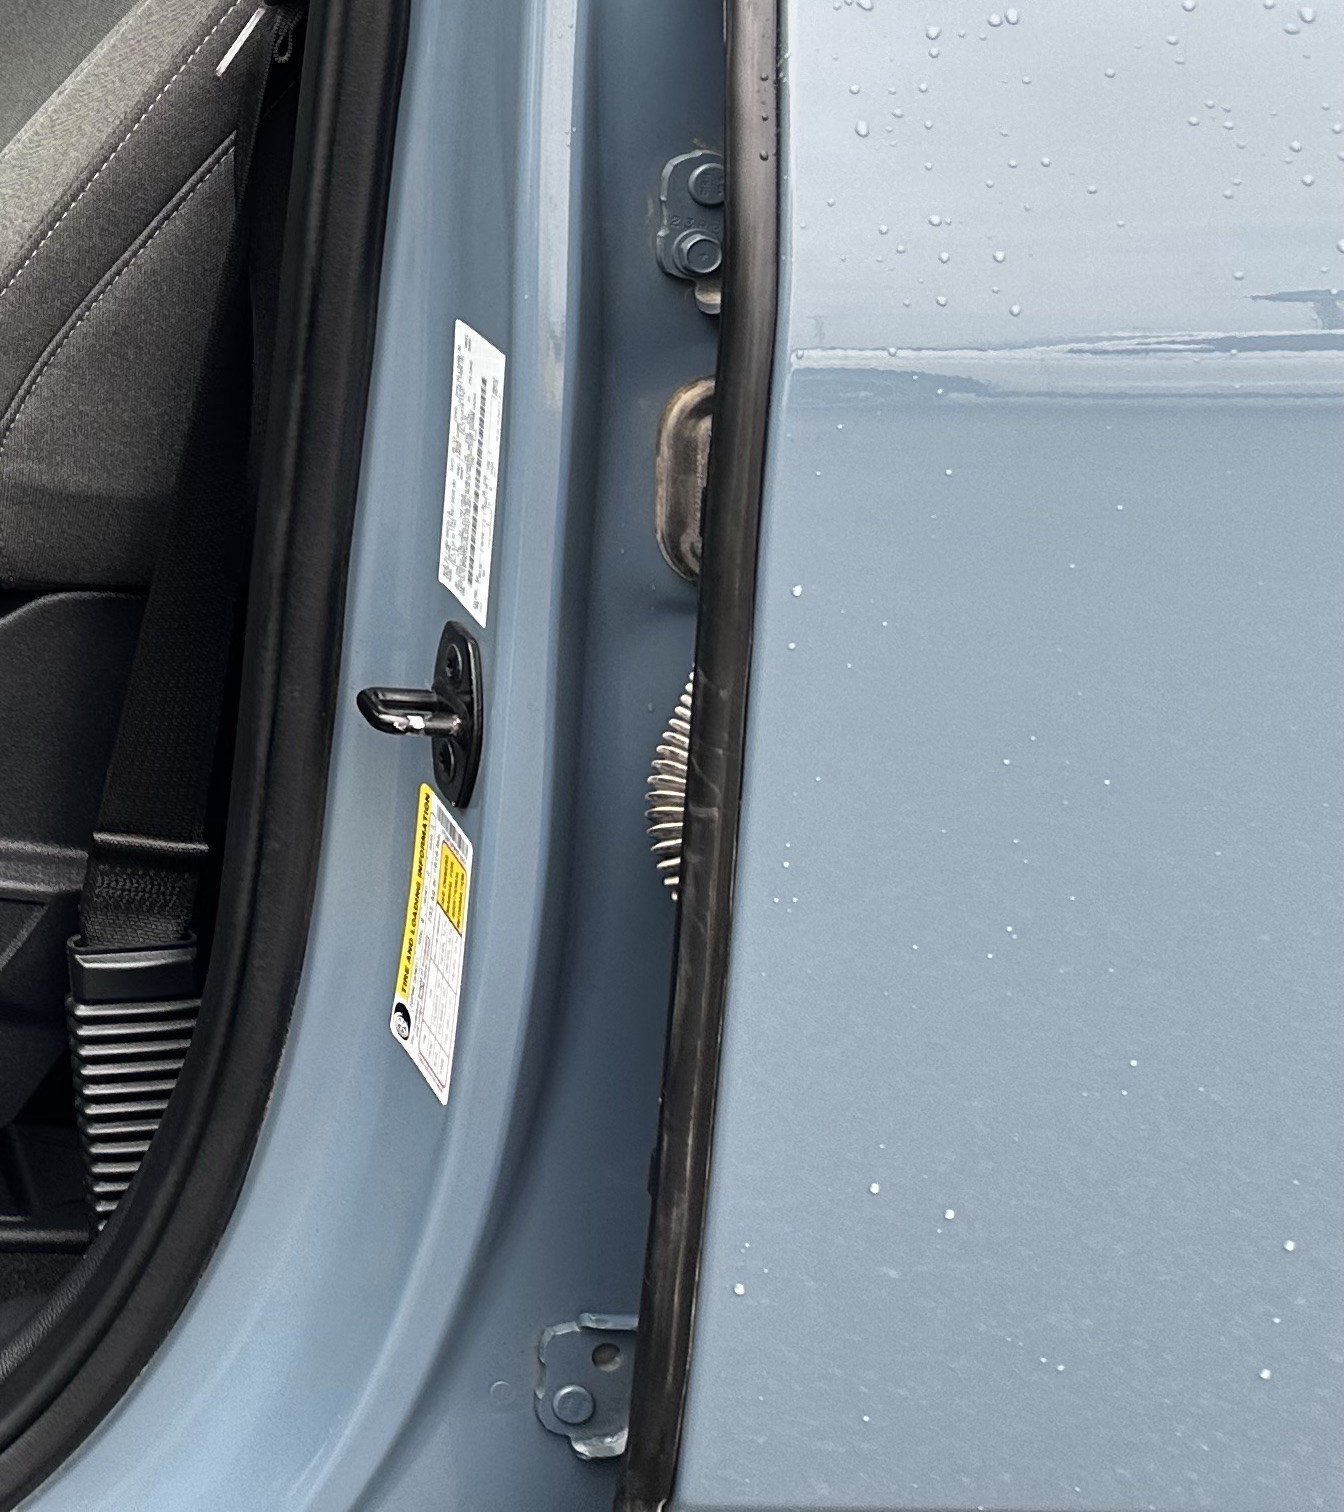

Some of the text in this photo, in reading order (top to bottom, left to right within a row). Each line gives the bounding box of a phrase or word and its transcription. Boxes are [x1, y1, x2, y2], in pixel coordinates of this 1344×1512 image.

[417, 792, 431, 879] INFORMATION
[410, 881, 421, 936] LOADING
[406, 936, 415, 963] AND
[401, 966, 411, 994] TIRE
